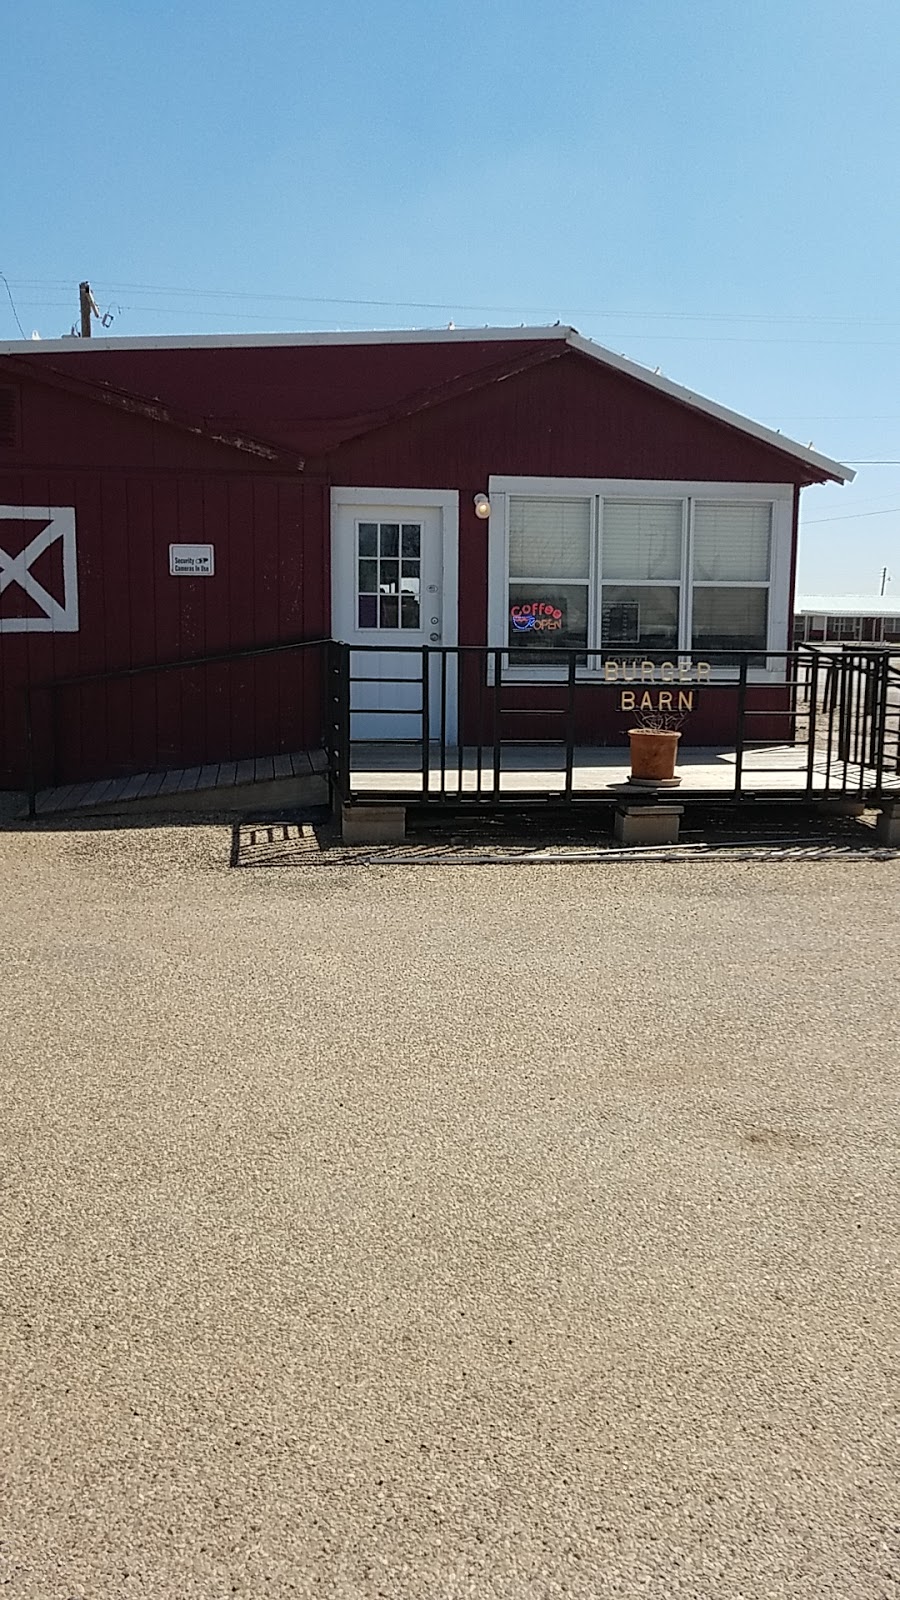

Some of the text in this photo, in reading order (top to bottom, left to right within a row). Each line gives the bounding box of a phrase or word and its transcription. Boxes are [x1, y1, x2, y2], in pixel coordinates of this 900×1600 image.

[175, 557, 194, 565] Security
[511, 603, 562, 619] Coffee
[533, 619, 562, 630] OPEN
[605, 661, 710, 682] BURGER
[621, 691, 693, 711] BARN
